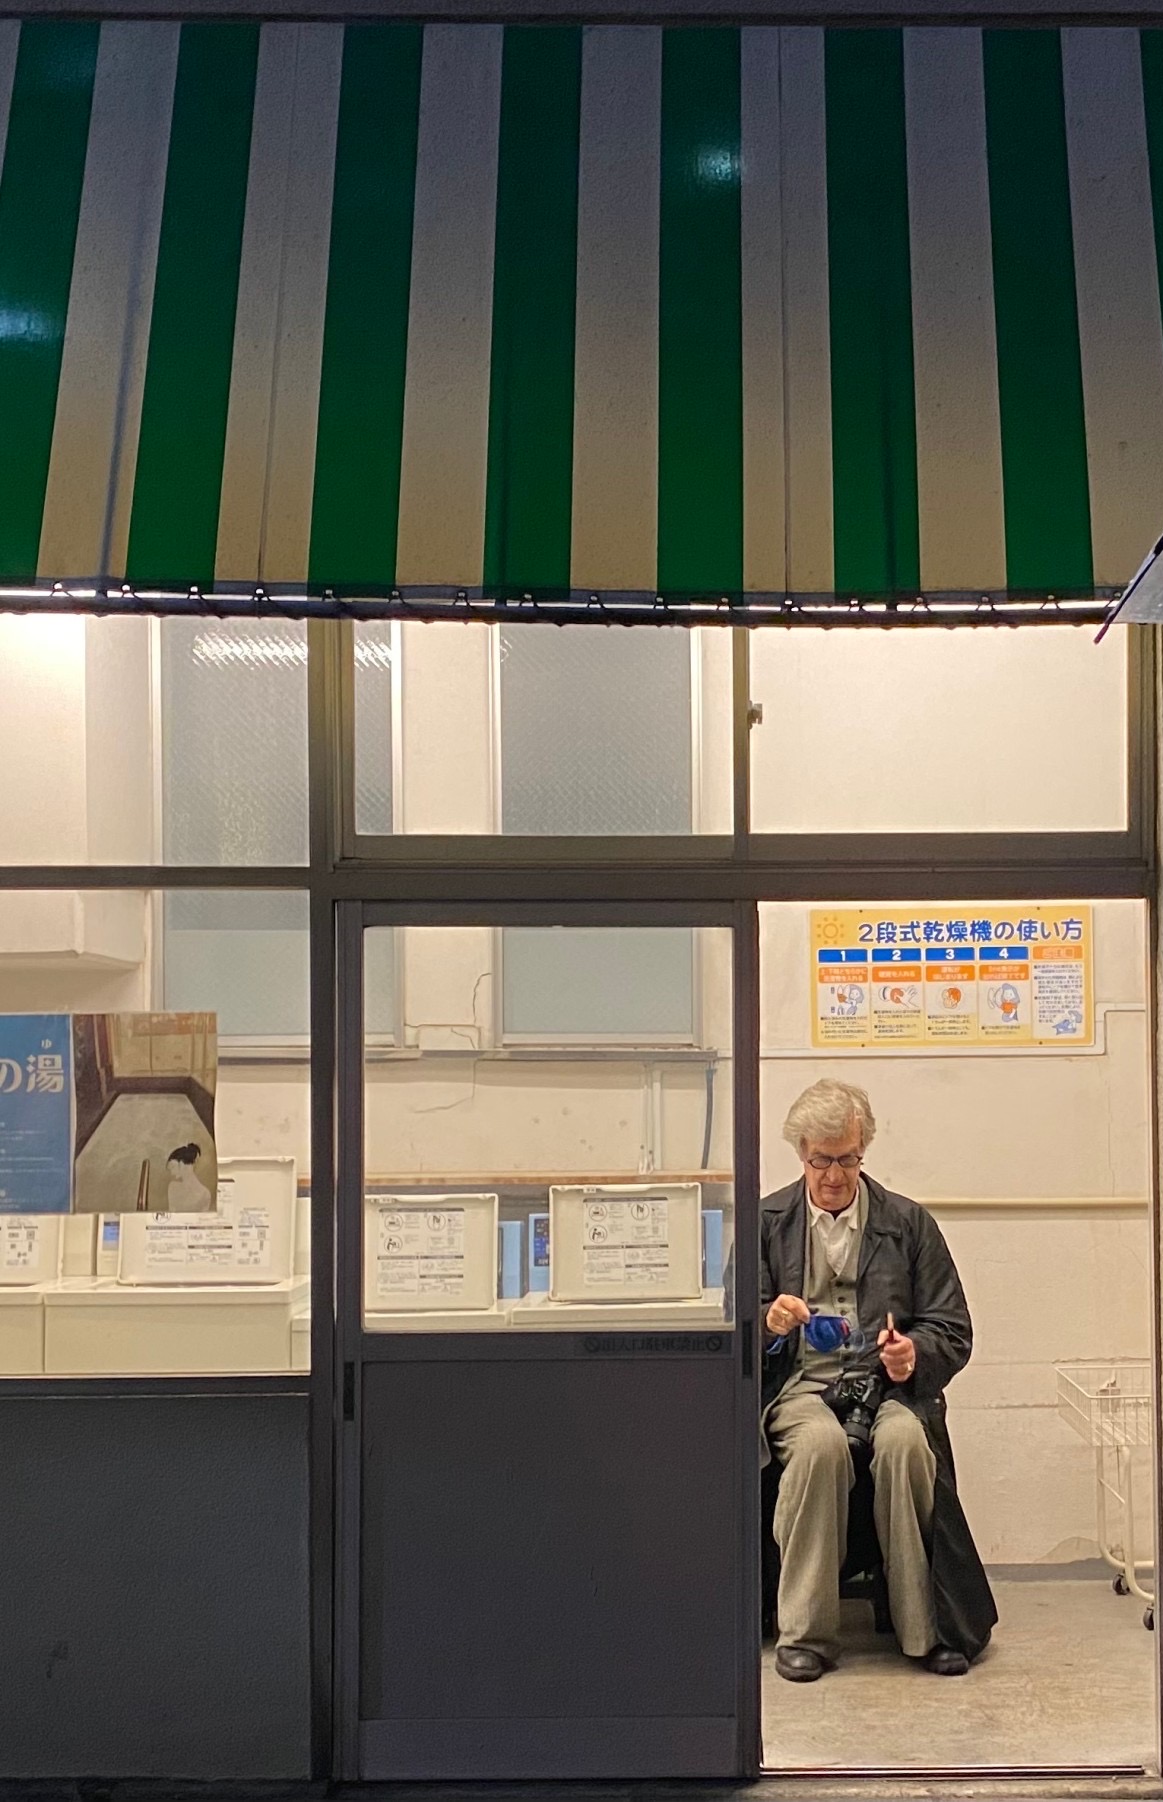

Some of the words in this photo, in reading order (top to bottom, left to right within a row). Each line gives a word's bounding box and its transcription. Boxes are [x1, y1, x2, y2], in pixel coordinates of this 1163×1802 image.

[858, 918, 1083, 944] 2段式乾燥機の使い方
[840, 950, 846, 961] 1
[892, 950, 901, 960] 2
[945, 949, 955, 960] 3
[998, 948, 1008, 959] 4
